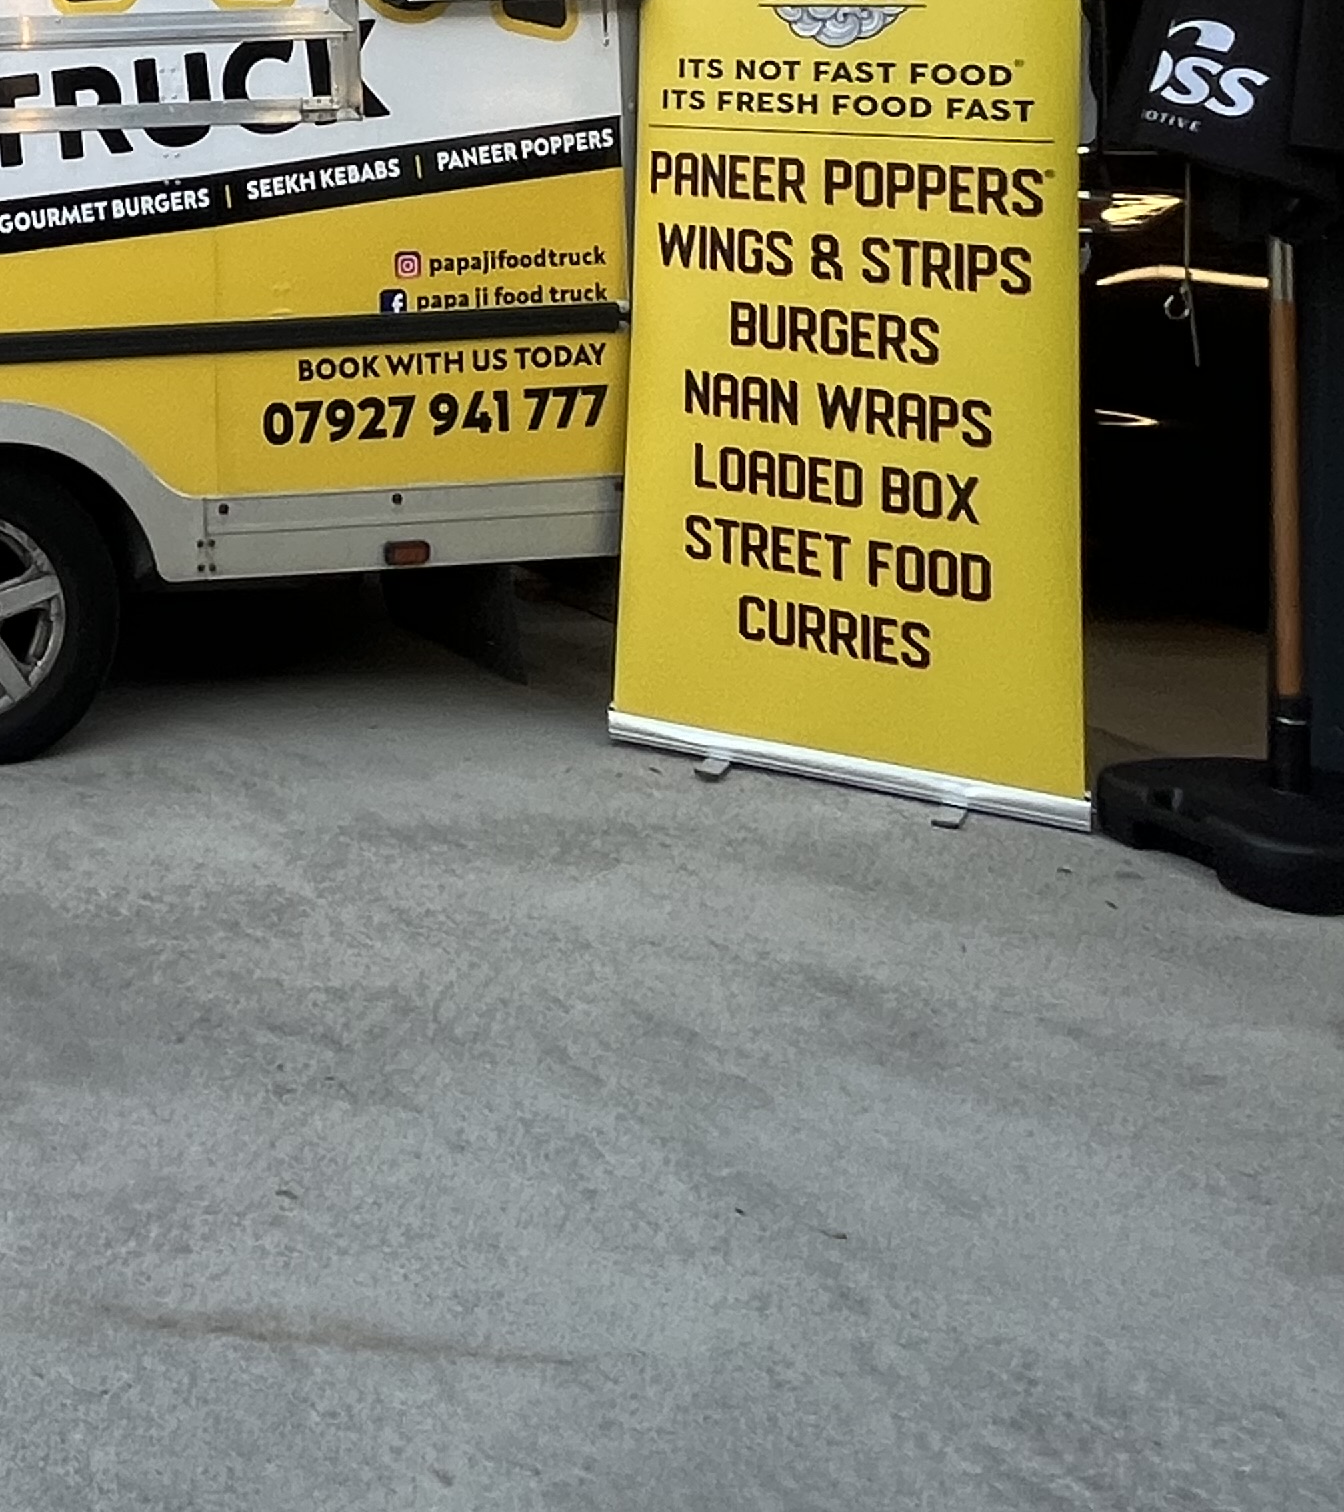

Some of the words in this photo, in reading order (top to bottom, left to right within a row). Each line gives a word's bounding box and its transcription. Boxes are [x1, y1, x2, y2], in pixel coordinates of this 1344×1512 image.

[678, 58, 723, 79] ITS
[735, 59, 801, 82] NOT
[814, 61, 896, 84] FAST
[662, 90, 706, 112] ITS
[717, 91, 818, 114] FRESH
[832, 94, 932, 118] FOOD
[946, 98, 1035, 122] FAST
[436, 141, 518, 171] PANEER
[521, 129, 614, 162] POPPERS
[650, 150, 807, 204] PANEER
[112, 188, 210, 218] BURGERS
[246, 170, 315, 200] SEEKH
[319, 159, 400, 189] KEBABS
[658, 222, 794, 277] WINGS
[811, 233, 843, 280] &
[862, 237, 1033, 295] STRIPS
[417, 292, 469, 311] papa
[494, 285, 542, 305] food
[549, 282, 607, 302] truck
[730, 300, 940, 365] BURGERS
[298, 355, 379, 381] BOOK
[385, 351, 463, 375] WITH
[473, 349, 508, 372] US
[514, 343, 606, 370] TODAY
[263, 394, 416, 446] 07927
[429, 390, 509, 436] 941
[524, 384, 608, 431] 777
[683, 368, 798, 426] NAAN
[817, 382, 992, 448] WRAPS
[694, 443, 863, 509] LOADED
[881, 465, 980, 525] BOX
[685, 515, 851, 582] STREET
[868, 541, 993, 603] FOOD
[738, 594, 930, 669] CURRIES
